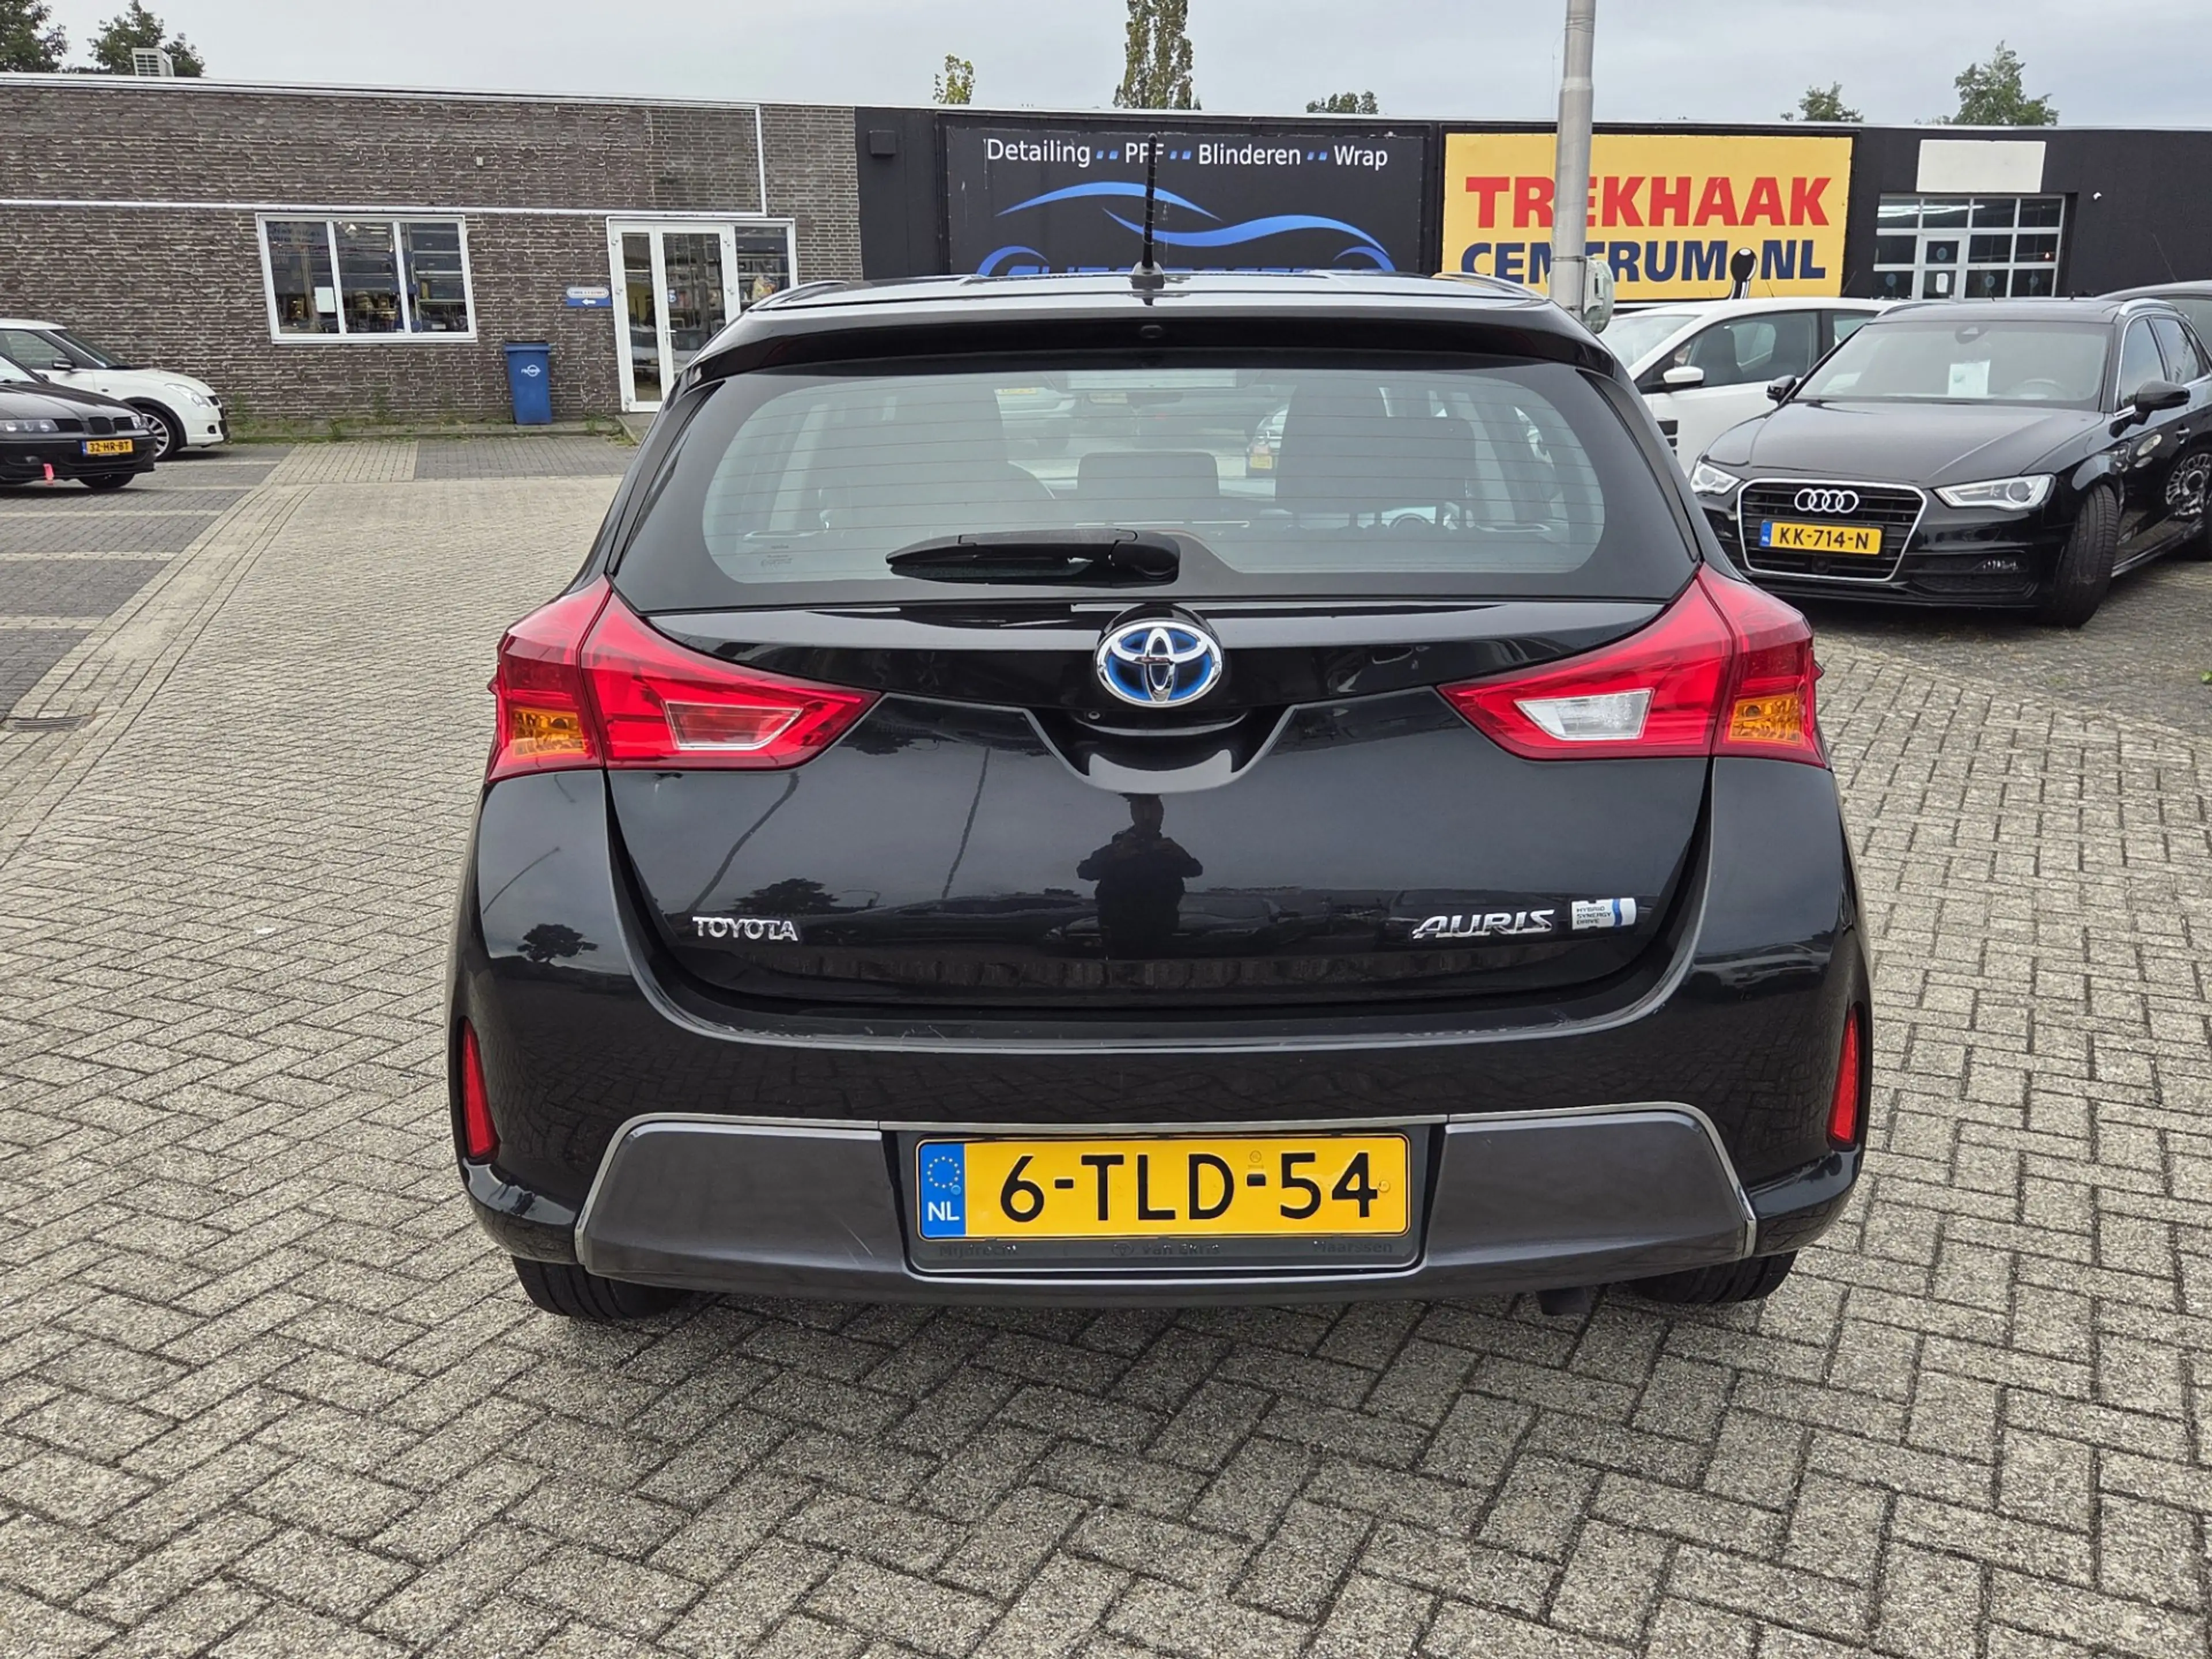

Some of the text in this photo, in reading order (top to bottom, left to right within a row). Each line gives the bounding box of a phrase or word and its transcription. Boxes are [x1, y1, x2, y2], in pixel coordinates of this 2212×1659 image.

[987, 138, 1090, 168] Detailing
[1198, 143, 1301, 165] Blinderen
[1334, 145, 1388, 171] Wrap
[1465, 176, 1831, 228] TRKHAAK
[1779, 527, 1869, 550] KK-714-N
[692, 916, 798, 941] TOYOTA
[1412, 908, 1555, 940] AURIS
[927, 1152, 1378, 1223] NL 6-TLD-54
